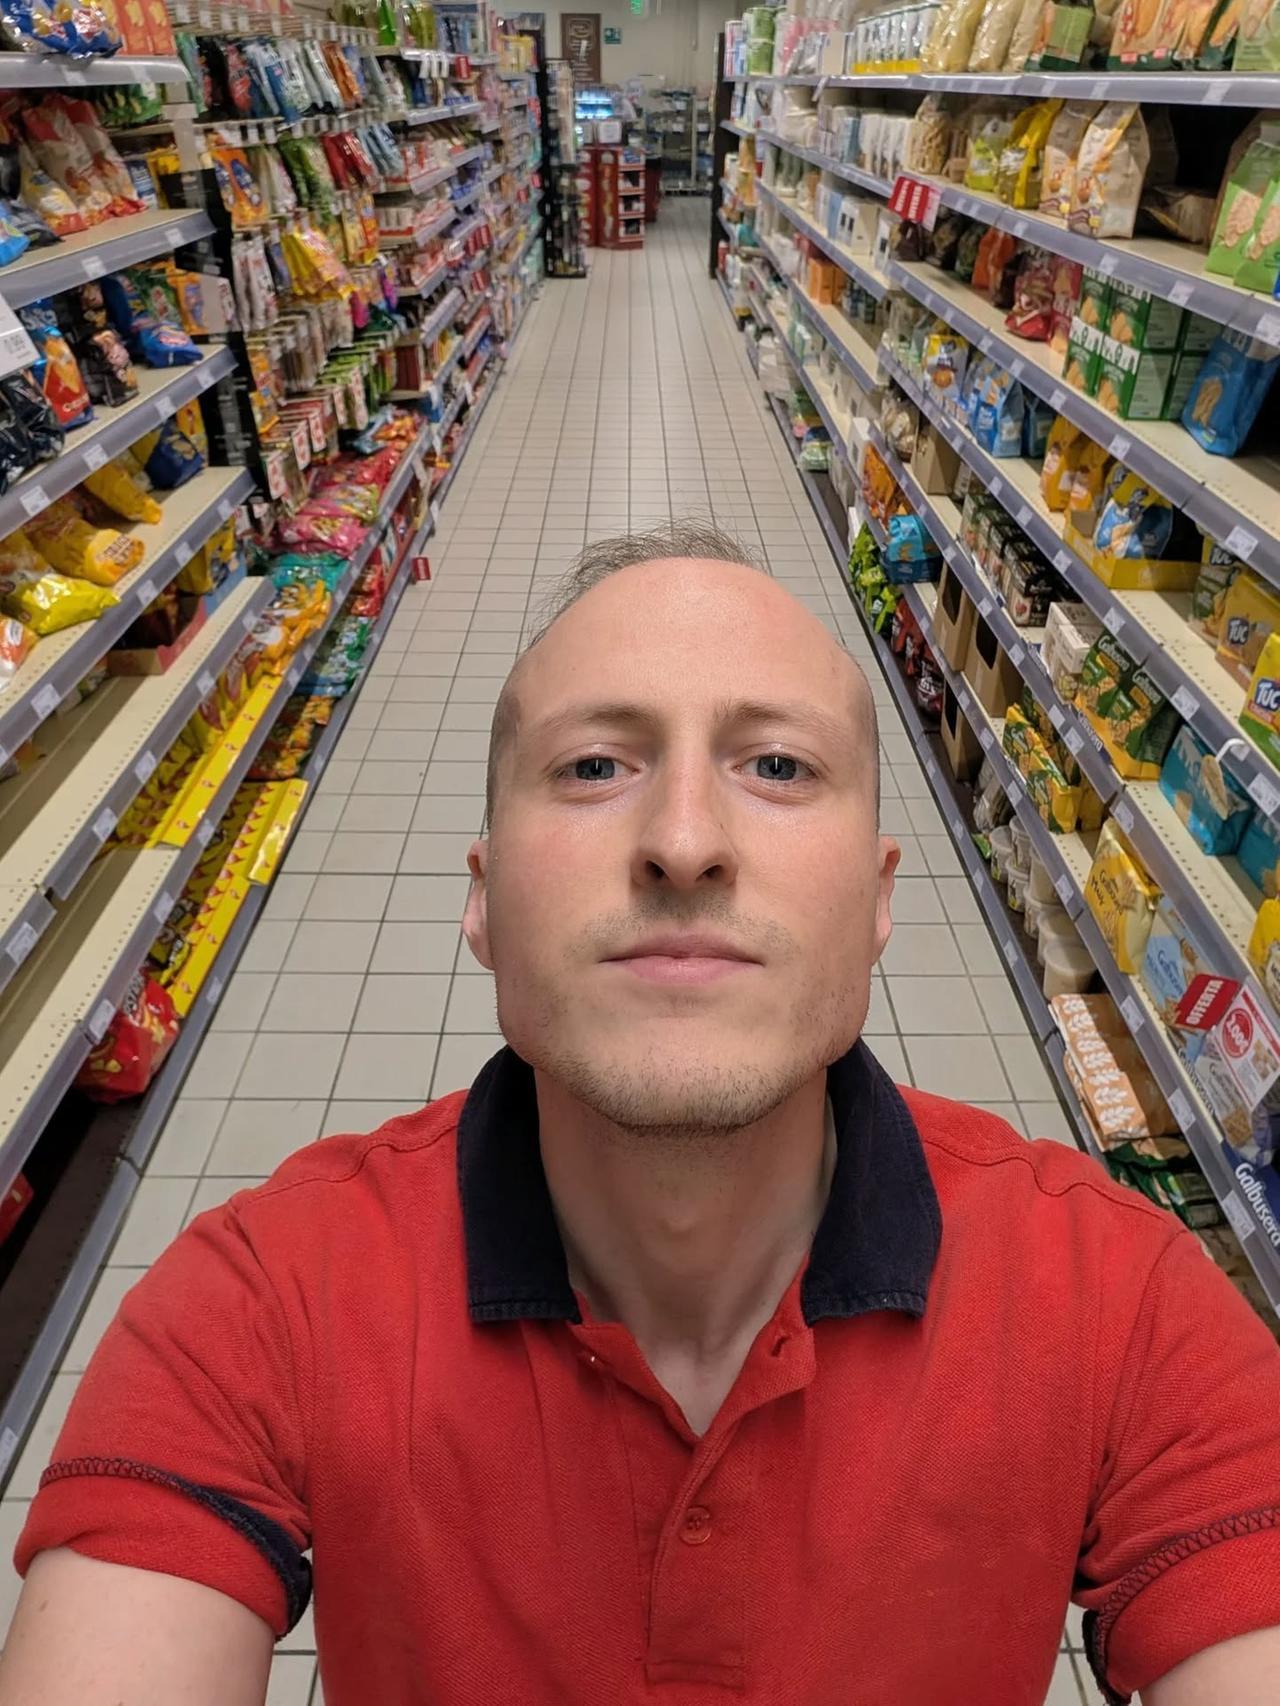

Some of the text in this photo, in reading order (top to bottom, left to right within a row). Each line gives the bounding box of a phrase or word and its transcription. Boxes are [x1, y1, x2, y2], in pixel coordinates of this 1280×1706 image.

[1228, 619, 1249, 643] TUC
[1256, 681, 1280, 710] TUC
[1185, 979, 1225, 1024] OFFERTA
[1235, 1162, 1280, 1248] Galbusera
